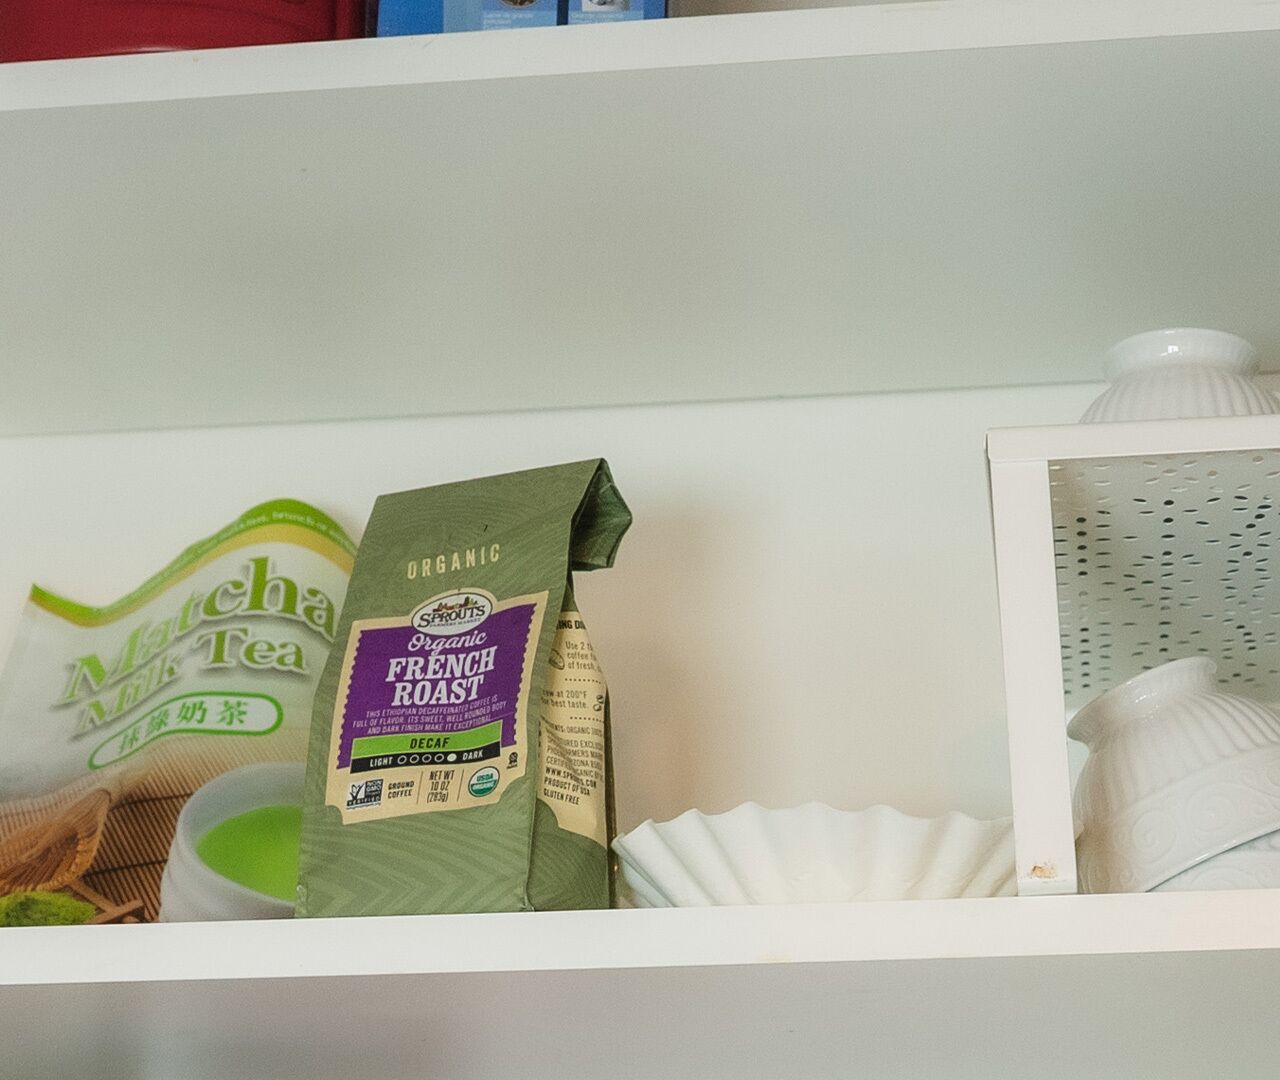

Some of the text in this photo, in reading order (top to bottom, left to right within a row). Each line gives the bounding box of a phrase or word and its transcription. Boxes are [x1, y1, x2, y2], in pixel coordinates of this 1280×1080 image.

[407, 544, 500, 579] ORGANIC
[417, 605, 485, 627] SPROUTS
[55, 555, 335, 702] Matcha
[408, 630, 487, 656] Organic
[385, 645, 498, 682] FRENCH
[78, 627, 307, 733] Milk Tea
[391, 675, 484, 706] ROAST
[410, 737, 450, 749] DECAF
[370, 749, 483, 767] LIGHT DARK
[429, 769, 455, 781] NET WT
[476, 773, 494, 782] USDA
[388, 781, 415, 791] GROUND
[388, 790, 413, 799] COFFEE
[430, 781, 451, 791] 10 OZ
